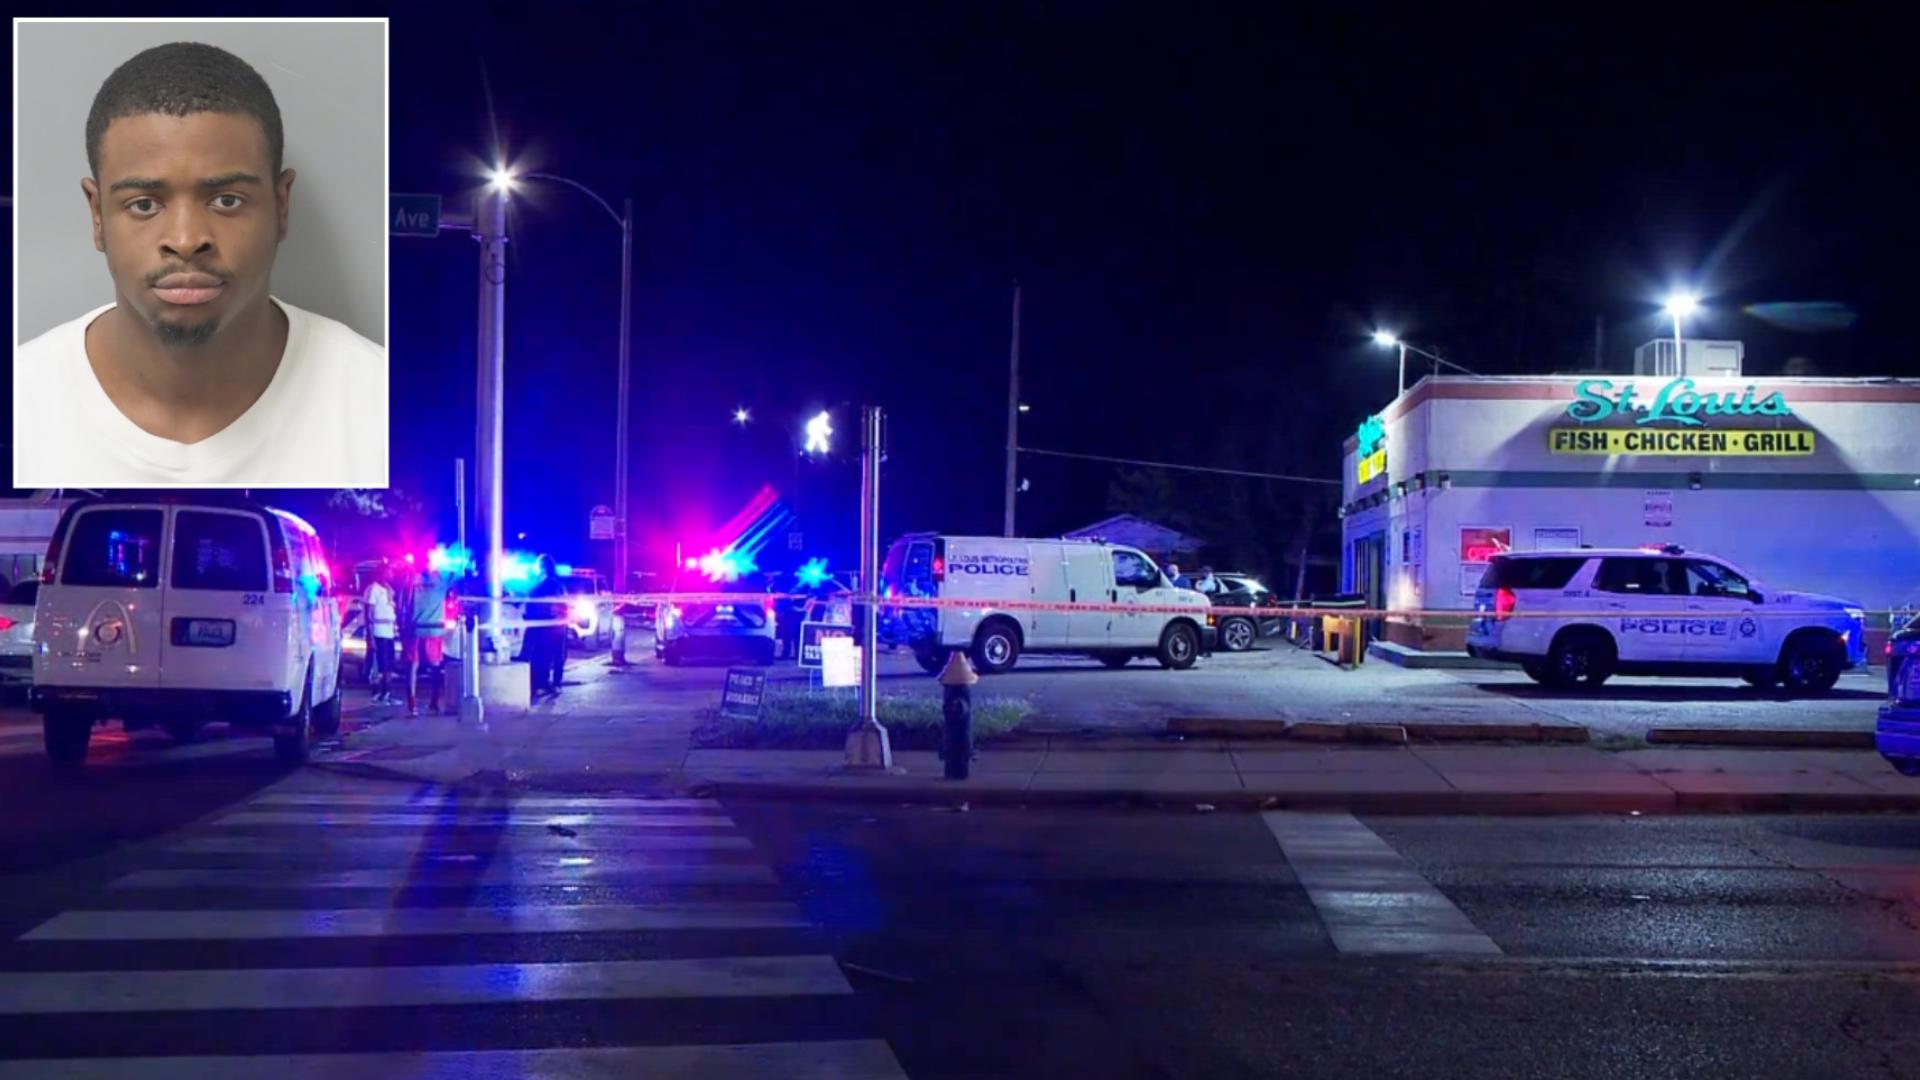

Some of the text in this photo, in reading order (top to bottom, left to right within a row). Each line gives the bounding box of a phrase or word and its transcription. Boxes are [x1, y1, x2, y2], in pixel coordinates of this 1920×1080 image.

[395, 207, 430, 228] Ave
[1636, 377, 1793, 425] Louis
[1555, 432, 1811, 451] FISH CHICKEN GRILL
[948, 563, 1029, 576] POLICE
[243, 594, 264, 605] 224
[1621, 622, 1727, 636] POLICE
